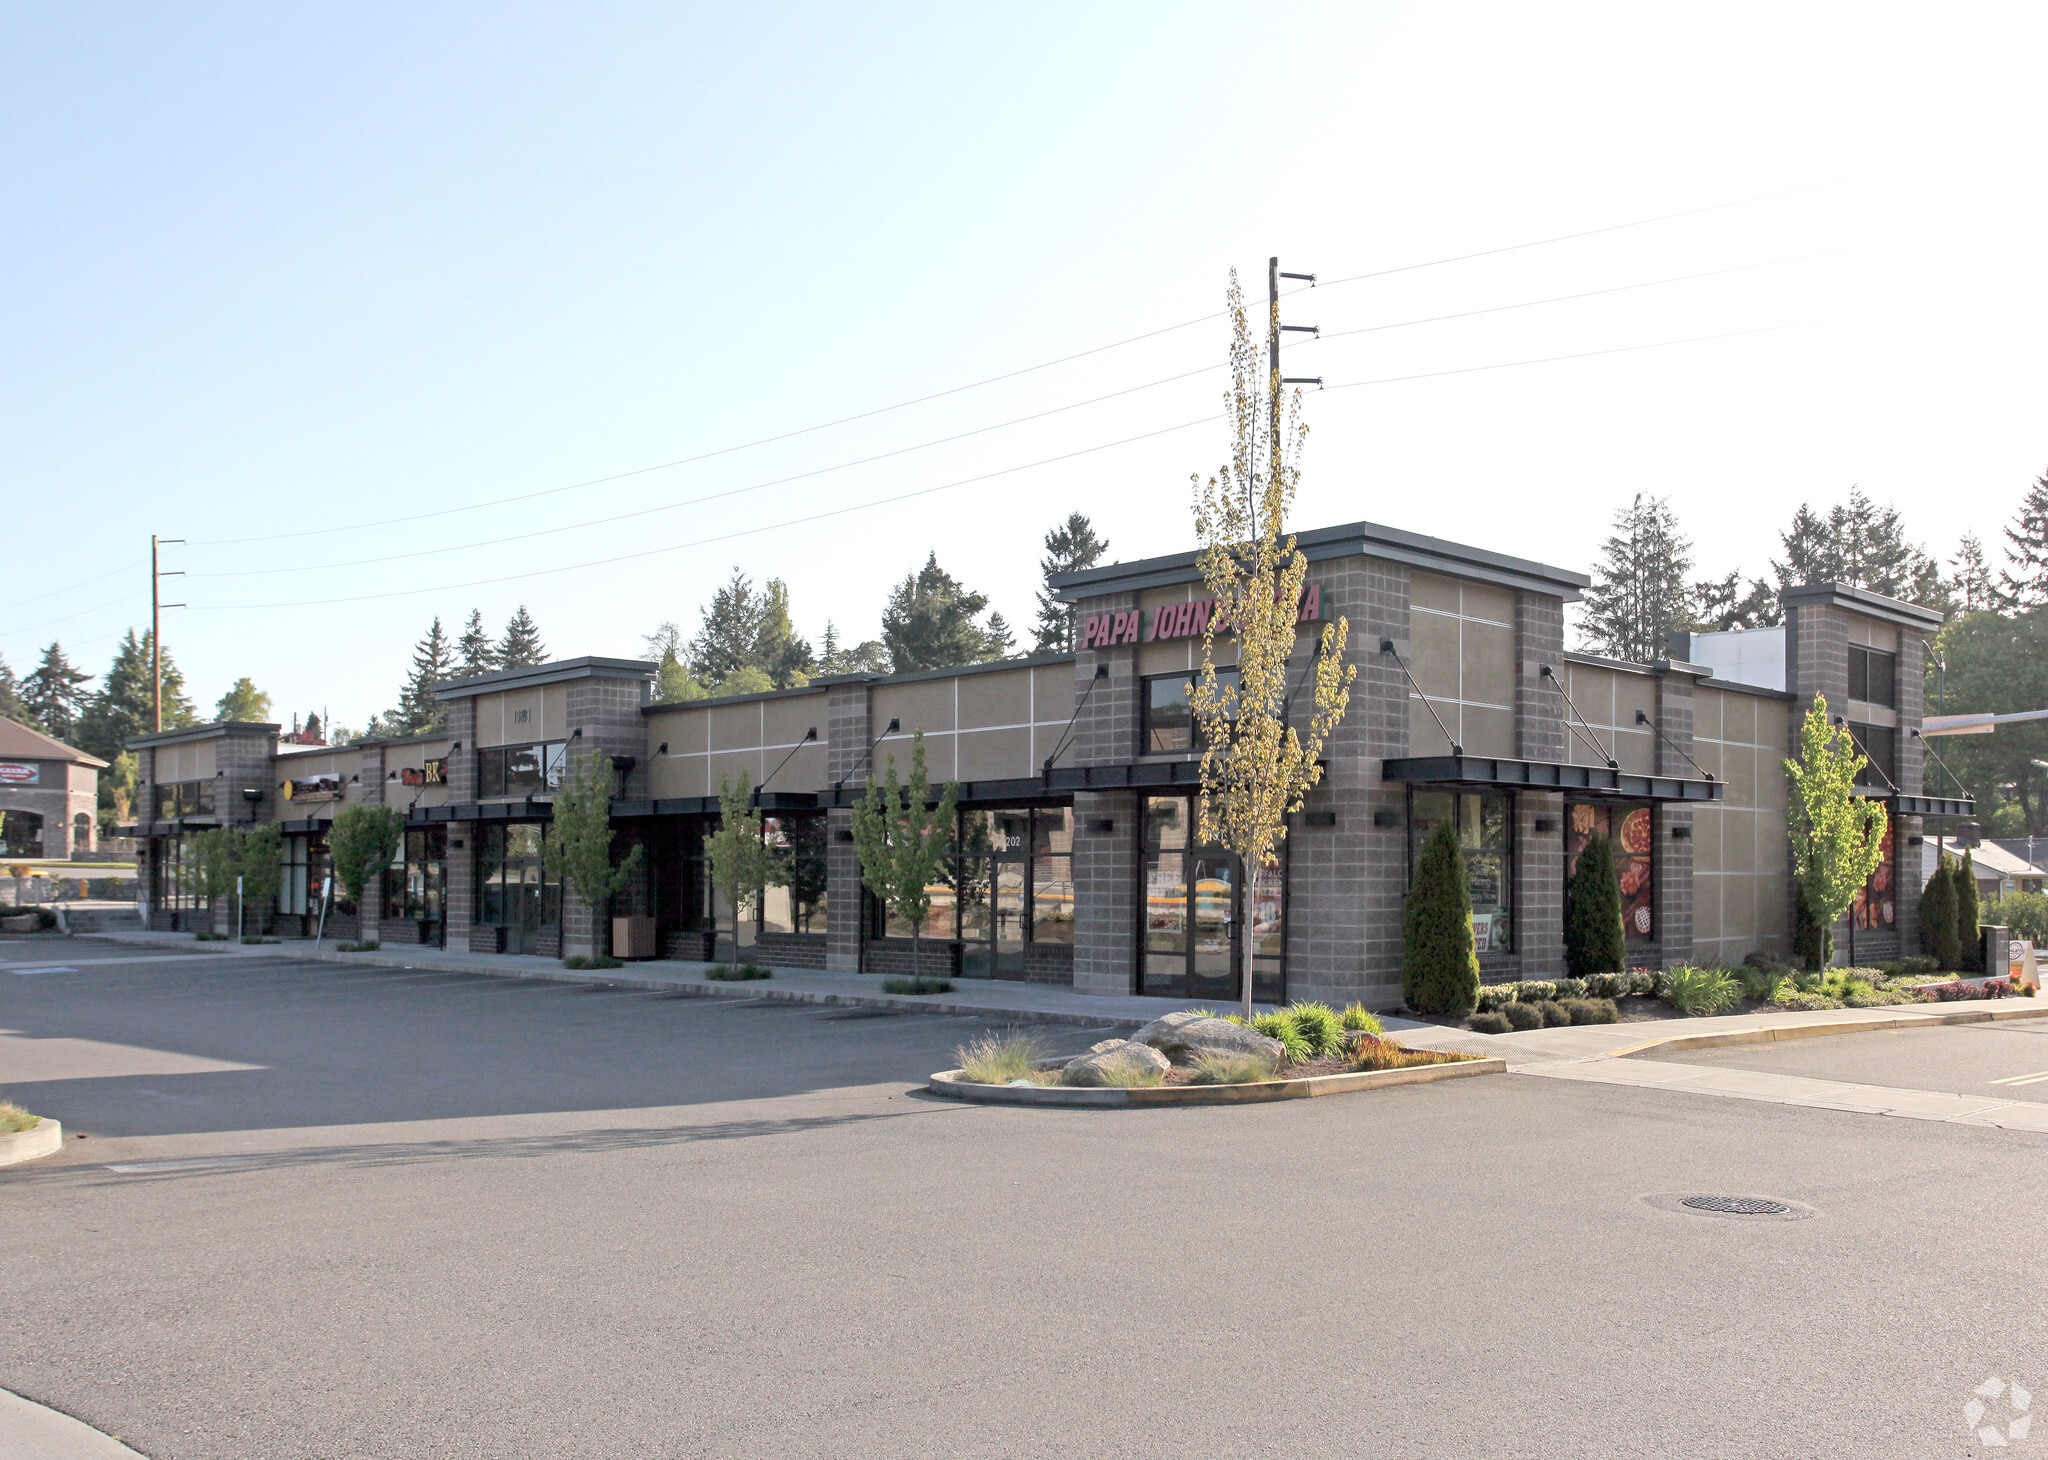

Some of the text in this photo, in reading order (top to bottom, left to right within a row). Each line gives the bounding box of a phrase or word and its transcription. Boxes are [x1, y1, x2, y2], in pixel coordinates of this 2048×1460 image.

[1081, 609, 1140, 648] PAPA
[425, 761, 440, 783] BK
[1006, 836, 1020, 847] 202
